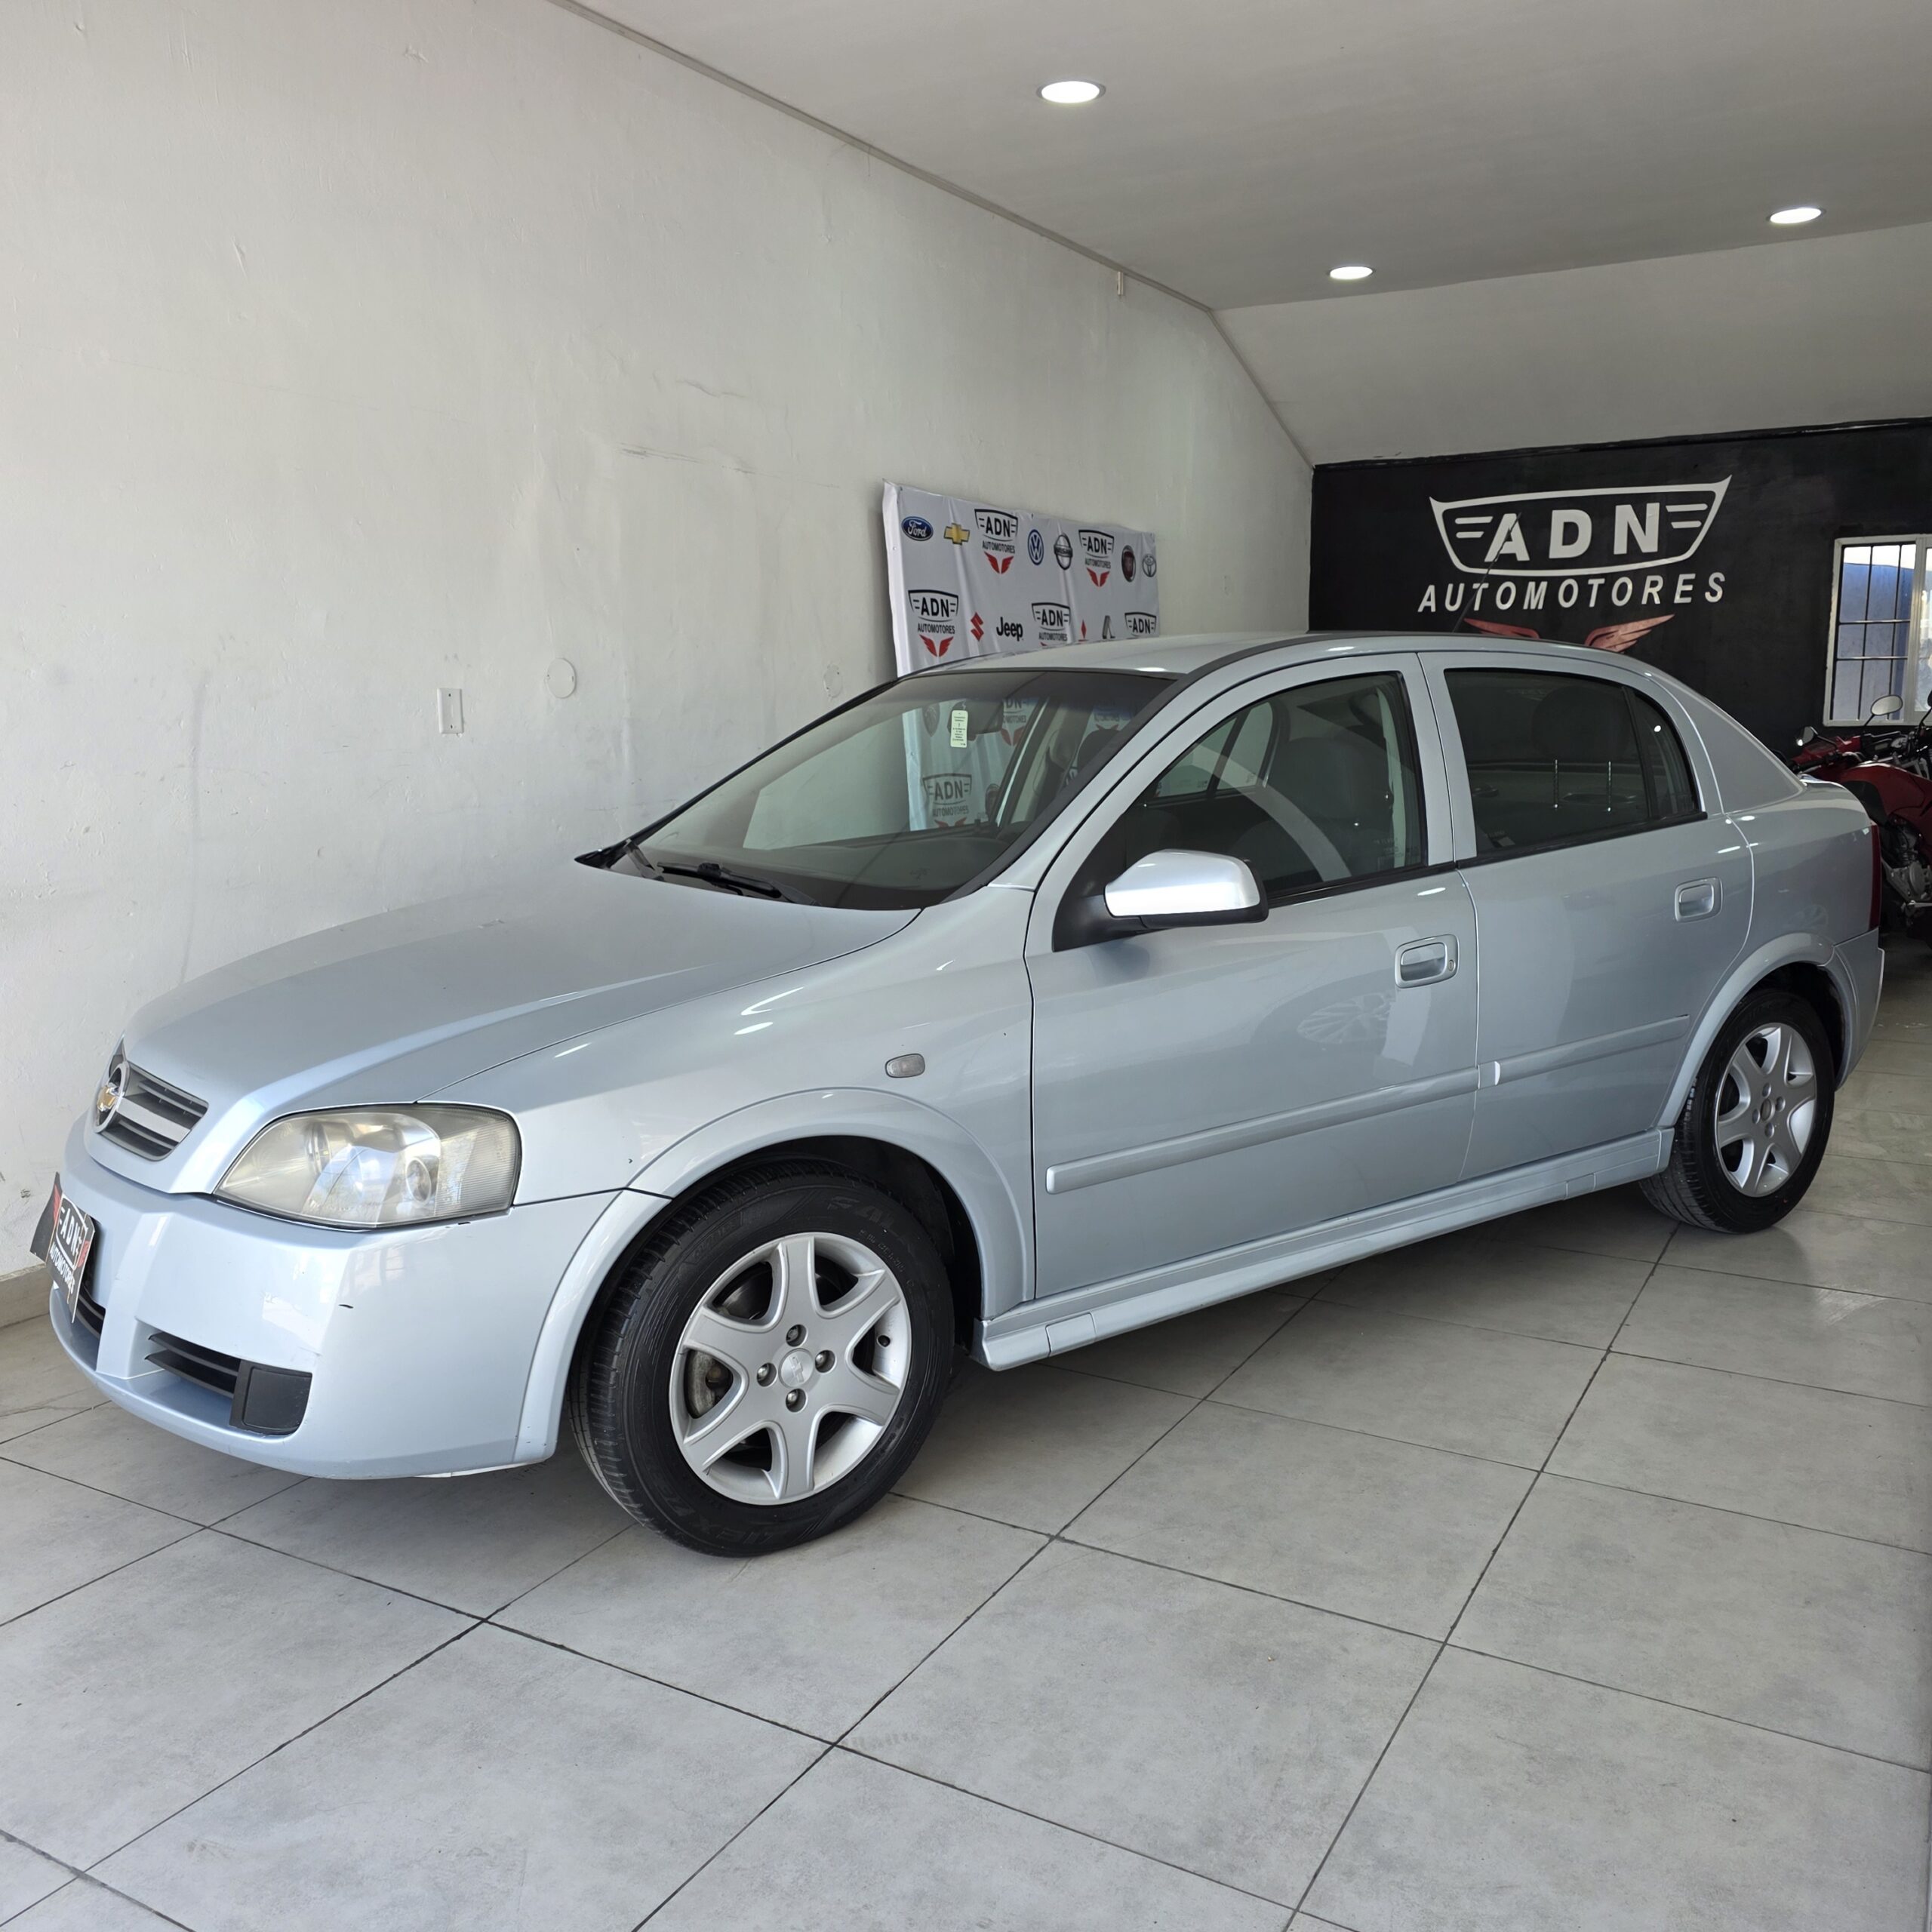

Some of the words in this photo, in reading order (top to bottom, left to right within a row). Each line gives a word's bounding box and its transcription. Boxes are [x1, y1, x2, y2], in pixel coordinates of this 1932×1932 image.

[908, 520, 927, 537] Ford
[986, 516, 1011, 537] ADN
[1484, 503, 1660, 562] ADN
[983, 540, 1015, 553] AUTOMOTORES
[1088, 537, 1107, 555] ADN
[1085, 558, 1111, 569] AUTOMOTORES
[1417, 572, 1725, 612] AUTOMOTORES
[921, 597, 949, 617] ADN
[1041, 609, 1063, 626] ADN
[1133, 618, 1151, 634] ADN
[918, 623, 955, 634] AUTOMOTORES
[996, 617, 1023, 641] Jeep
[1038, 632, 1067, 641] AUTOMOTORES
[935, 780, 963, 801] ADN
[60, 1208, 80, 1256] ADN
[50, 1241, 75, 1294] AUTOMOTORES
